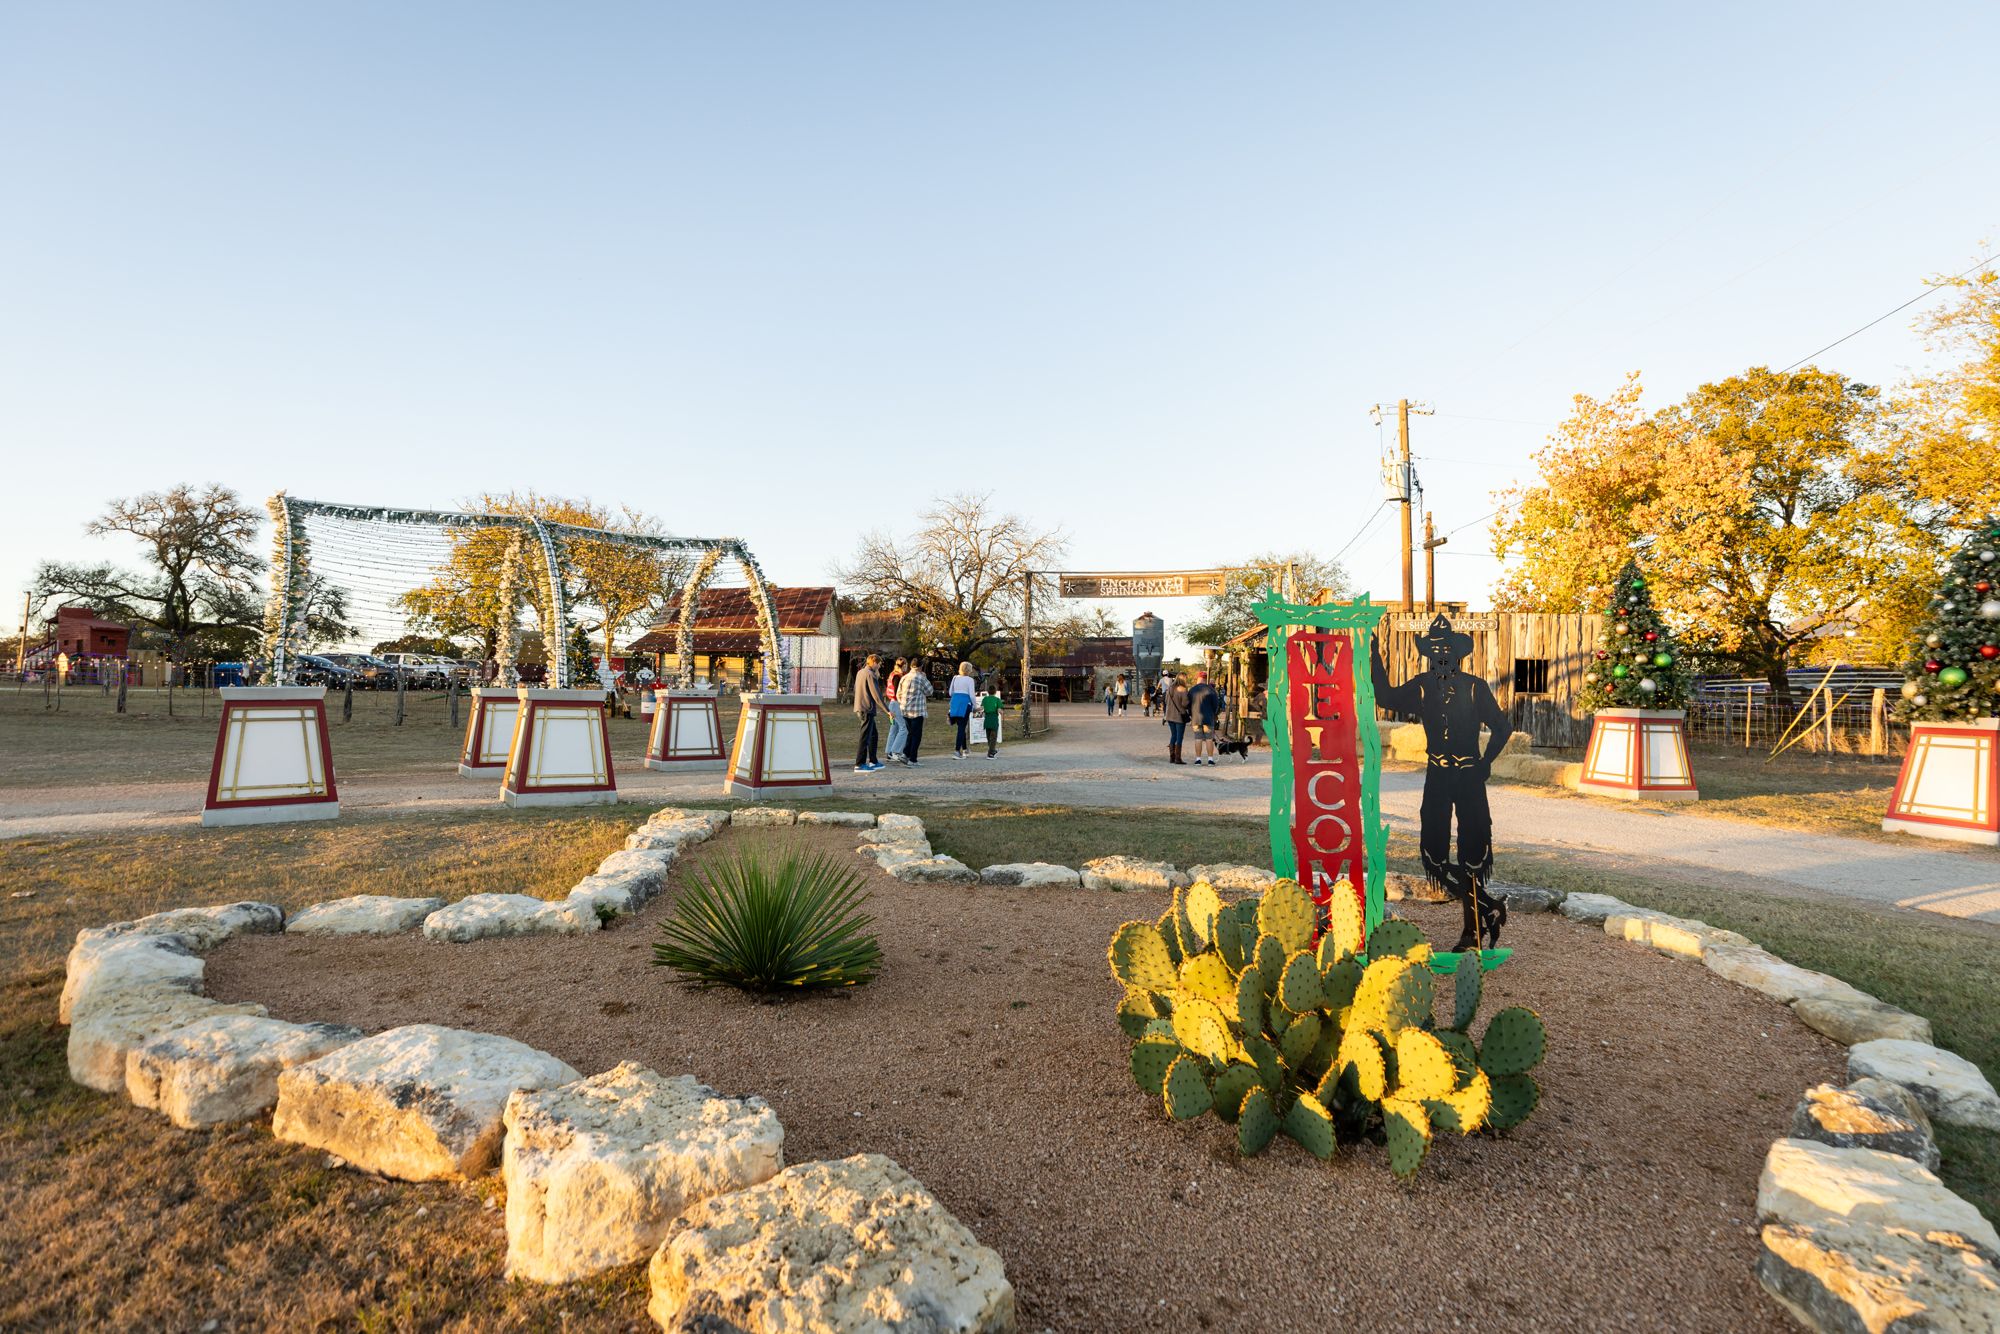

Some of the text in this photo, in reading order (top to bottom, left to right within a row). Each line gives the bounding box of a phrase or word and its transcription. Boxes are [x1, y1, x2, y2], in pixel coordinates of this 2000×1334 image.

[1101, 577, 1184, 588] ENCHANTED
[1100, 586, 1184, 596] SPRINGS RANCH
[1409, 621, 1431, 630] SHER
